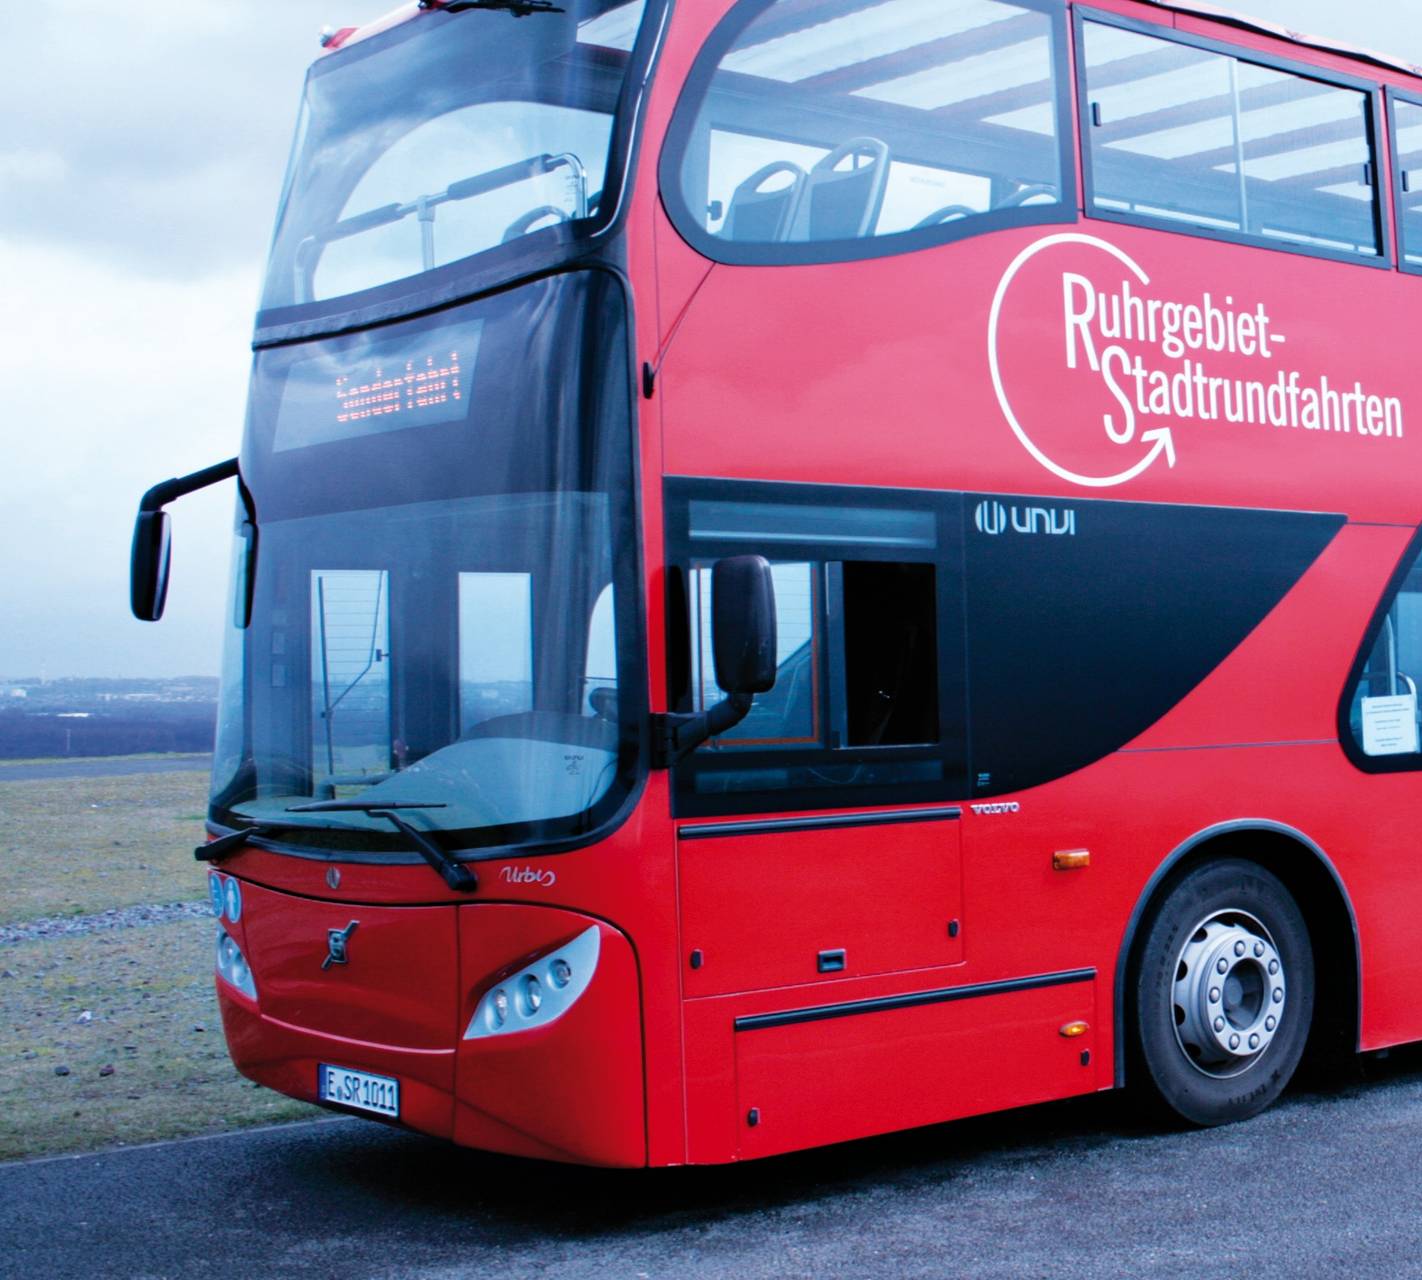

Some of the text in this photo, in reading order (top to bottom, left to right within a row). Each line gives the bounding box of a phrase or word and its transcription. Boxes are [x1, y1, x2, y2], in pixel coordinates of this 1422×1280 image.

[1062, 272, 1286, 371] Ruhrgebiet-
[1099, 344, 1404, 444] Stadtrundfahrten
[970, 801, 1020, 815] VOLVO
[499, 865, 557, 887] Urbis
[327, 1071, 335, 1097] E
